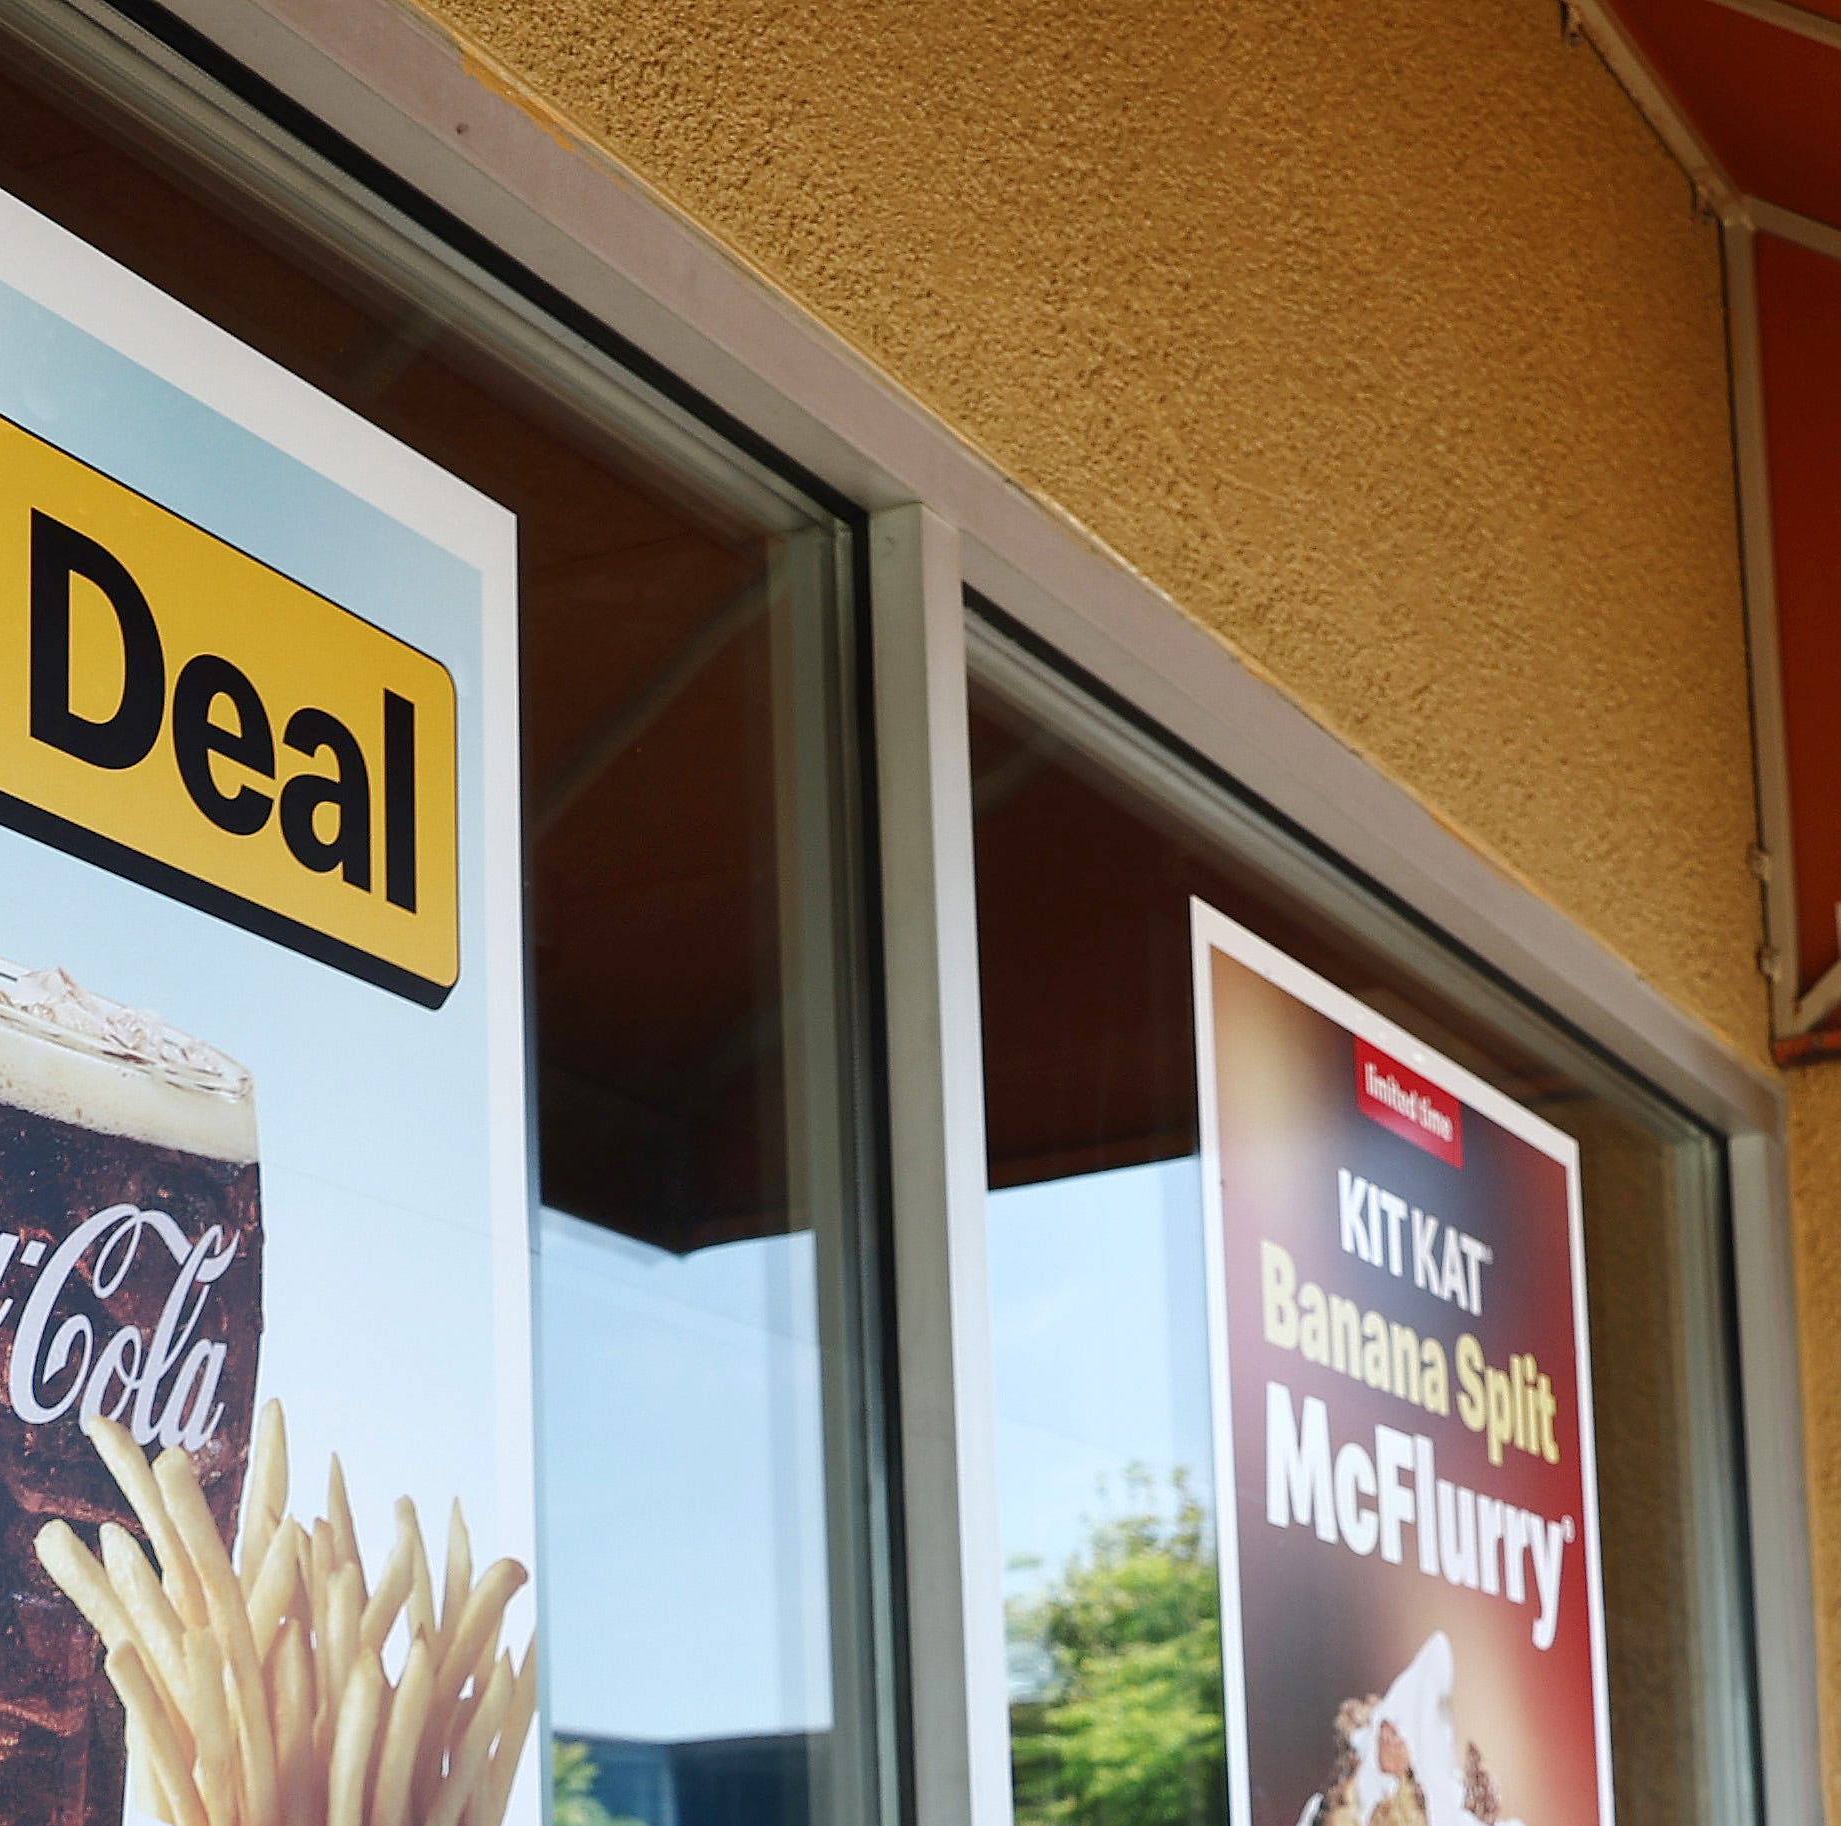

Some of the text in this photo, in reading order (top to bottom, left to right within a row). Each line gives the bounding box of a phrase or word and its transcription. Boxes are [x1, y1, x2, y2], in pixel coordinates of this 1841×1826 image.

[28, 506, 417, 914] Deal
[1338, 1166, 1408, 1277] KIT
[1260, 1238, 1560, 1468] Banana Split
